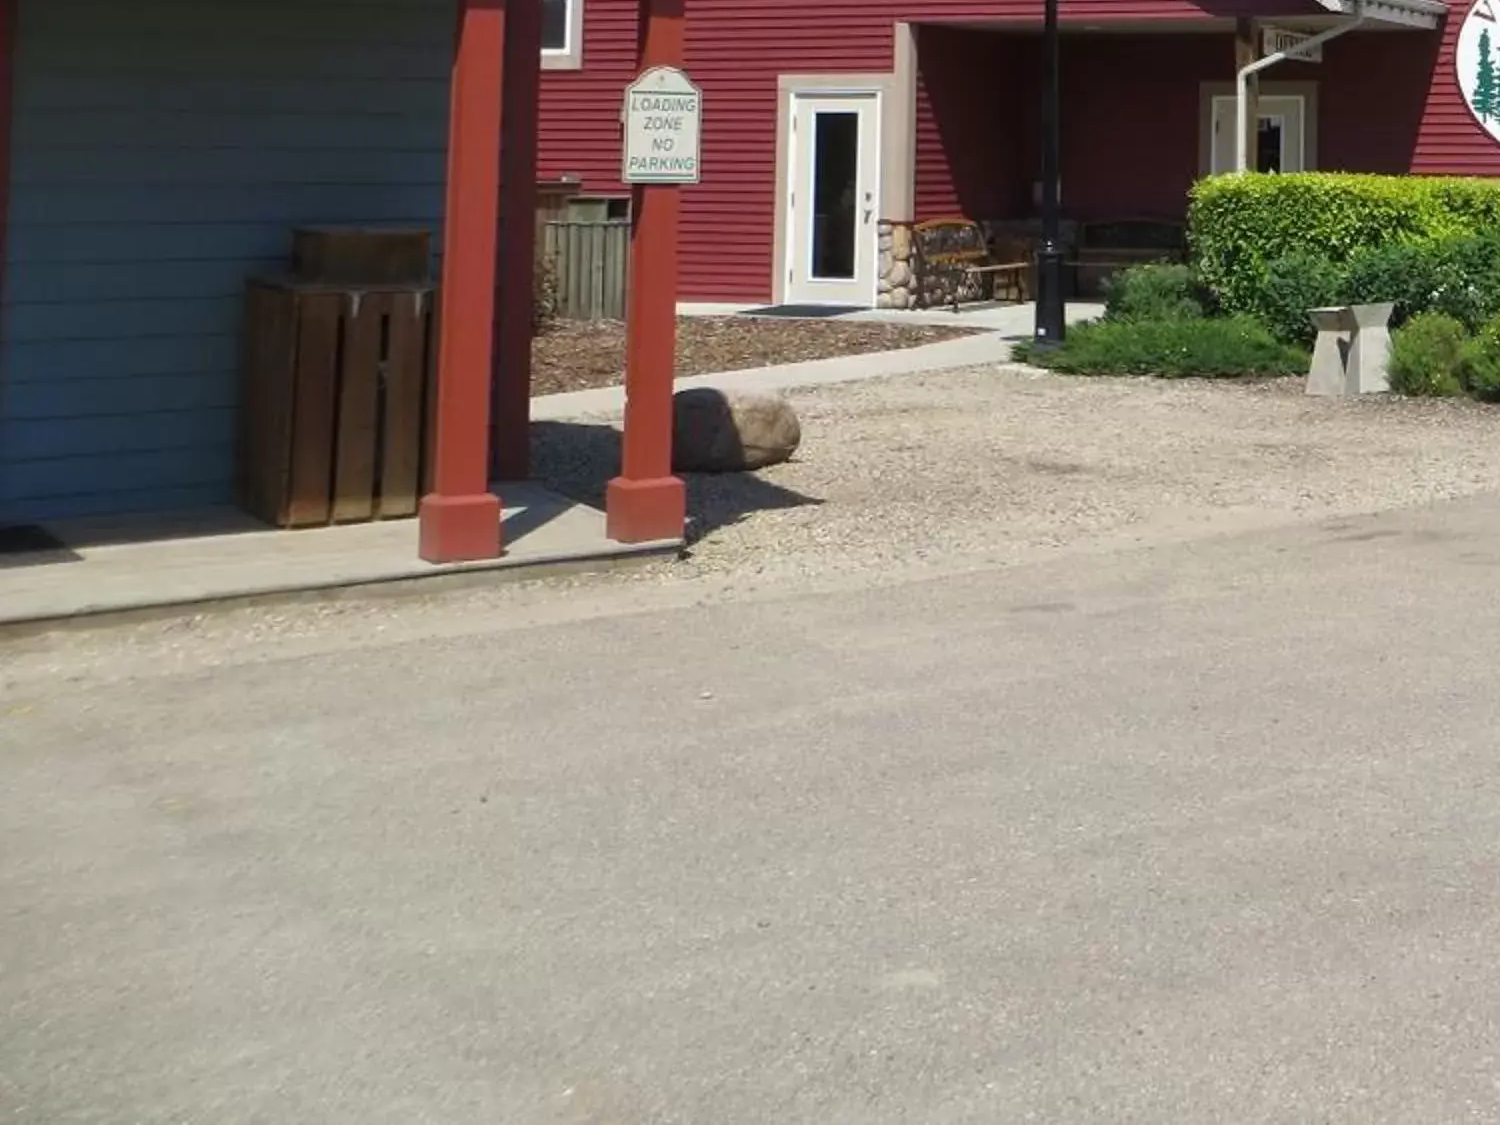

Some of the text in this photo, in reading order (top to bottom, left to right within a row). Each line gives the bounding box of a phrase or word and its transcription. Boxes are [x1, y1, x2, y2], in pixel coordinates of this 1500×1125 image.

[631, 97, 696, 112] LOADING
[643, 116, 684, 131] ZONE
[651, 138, 675, 152] NO
[629, 156, 696, 171] PARKING
